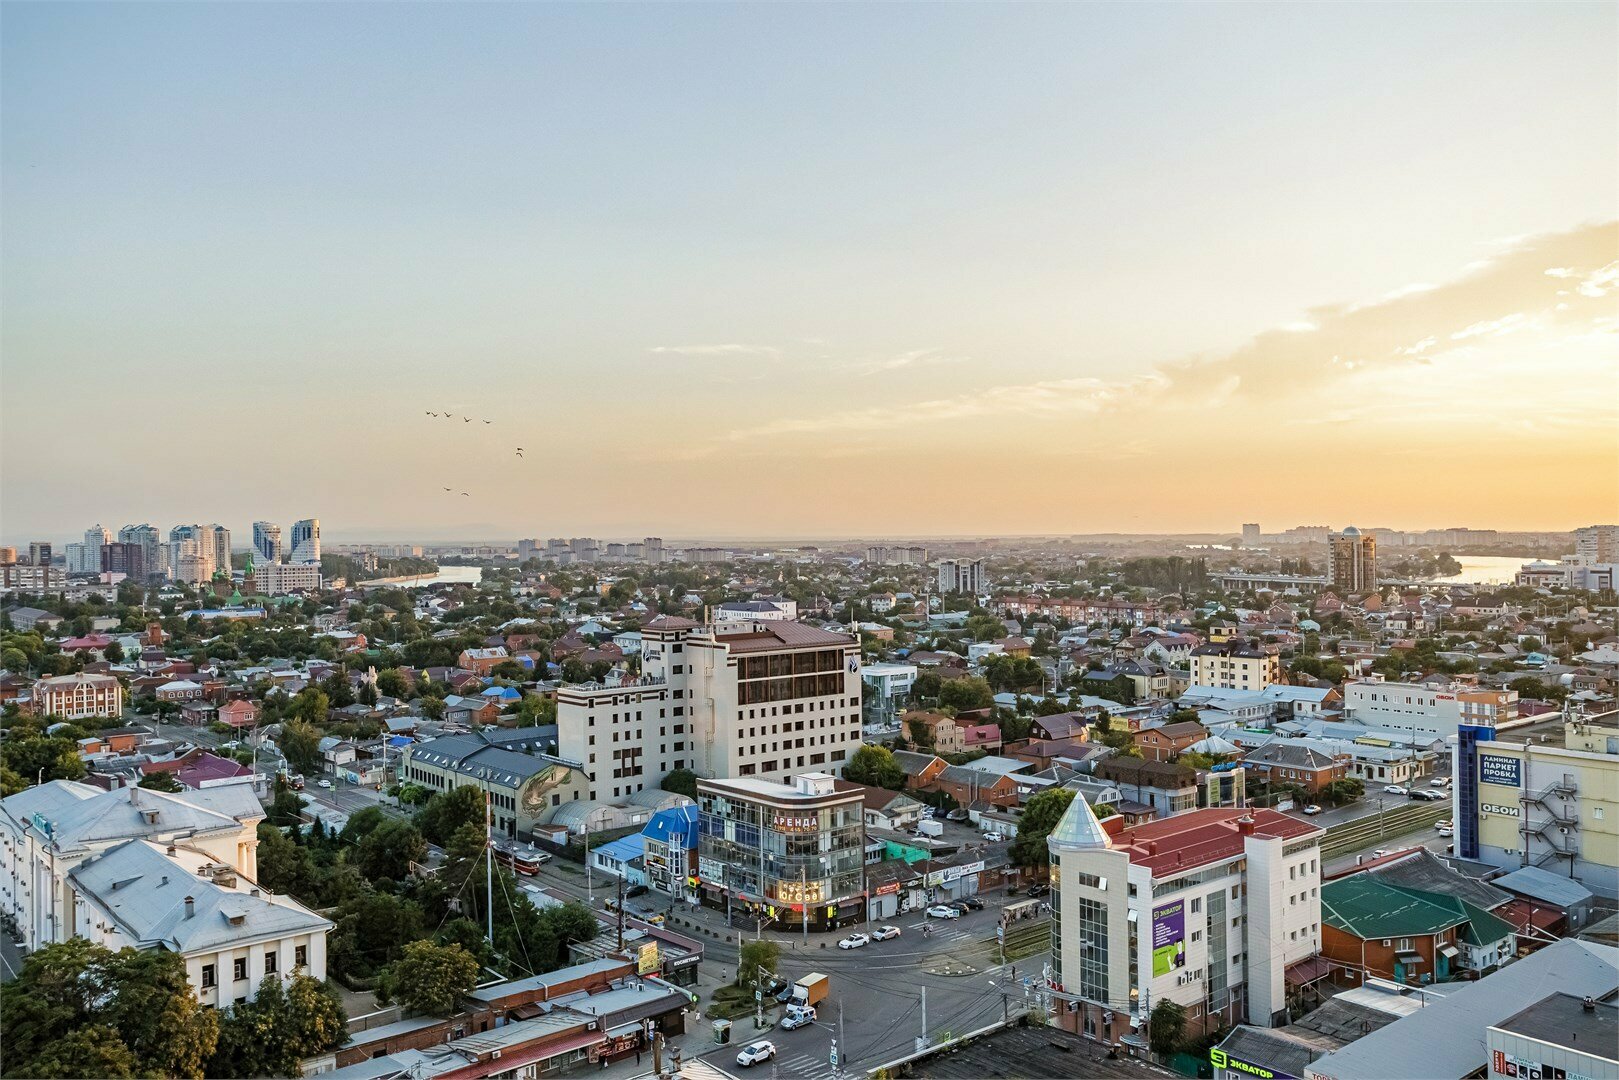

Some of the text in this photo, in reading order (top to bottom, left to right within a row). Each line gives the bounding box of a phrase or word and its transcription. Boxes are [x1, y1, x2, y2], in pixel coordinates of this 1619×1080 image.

[1484, 756, 1516, 765] ЛАМИНАТ
[1484, 761, 1516, 772] ПАРКЕТ
[1484, 768, 1517, 779] ПРОБКА
[1482, 804, 1518, 816] ОБОИ
[773, 816, 818, 829] АРЕНДА
[1160, 904, 1182, 916] ЭКВАТОР
[673, 955, 700, 967] КОСМЕТИКА
[1229, 1059, 1274, 1079] ЭКВАТОР
